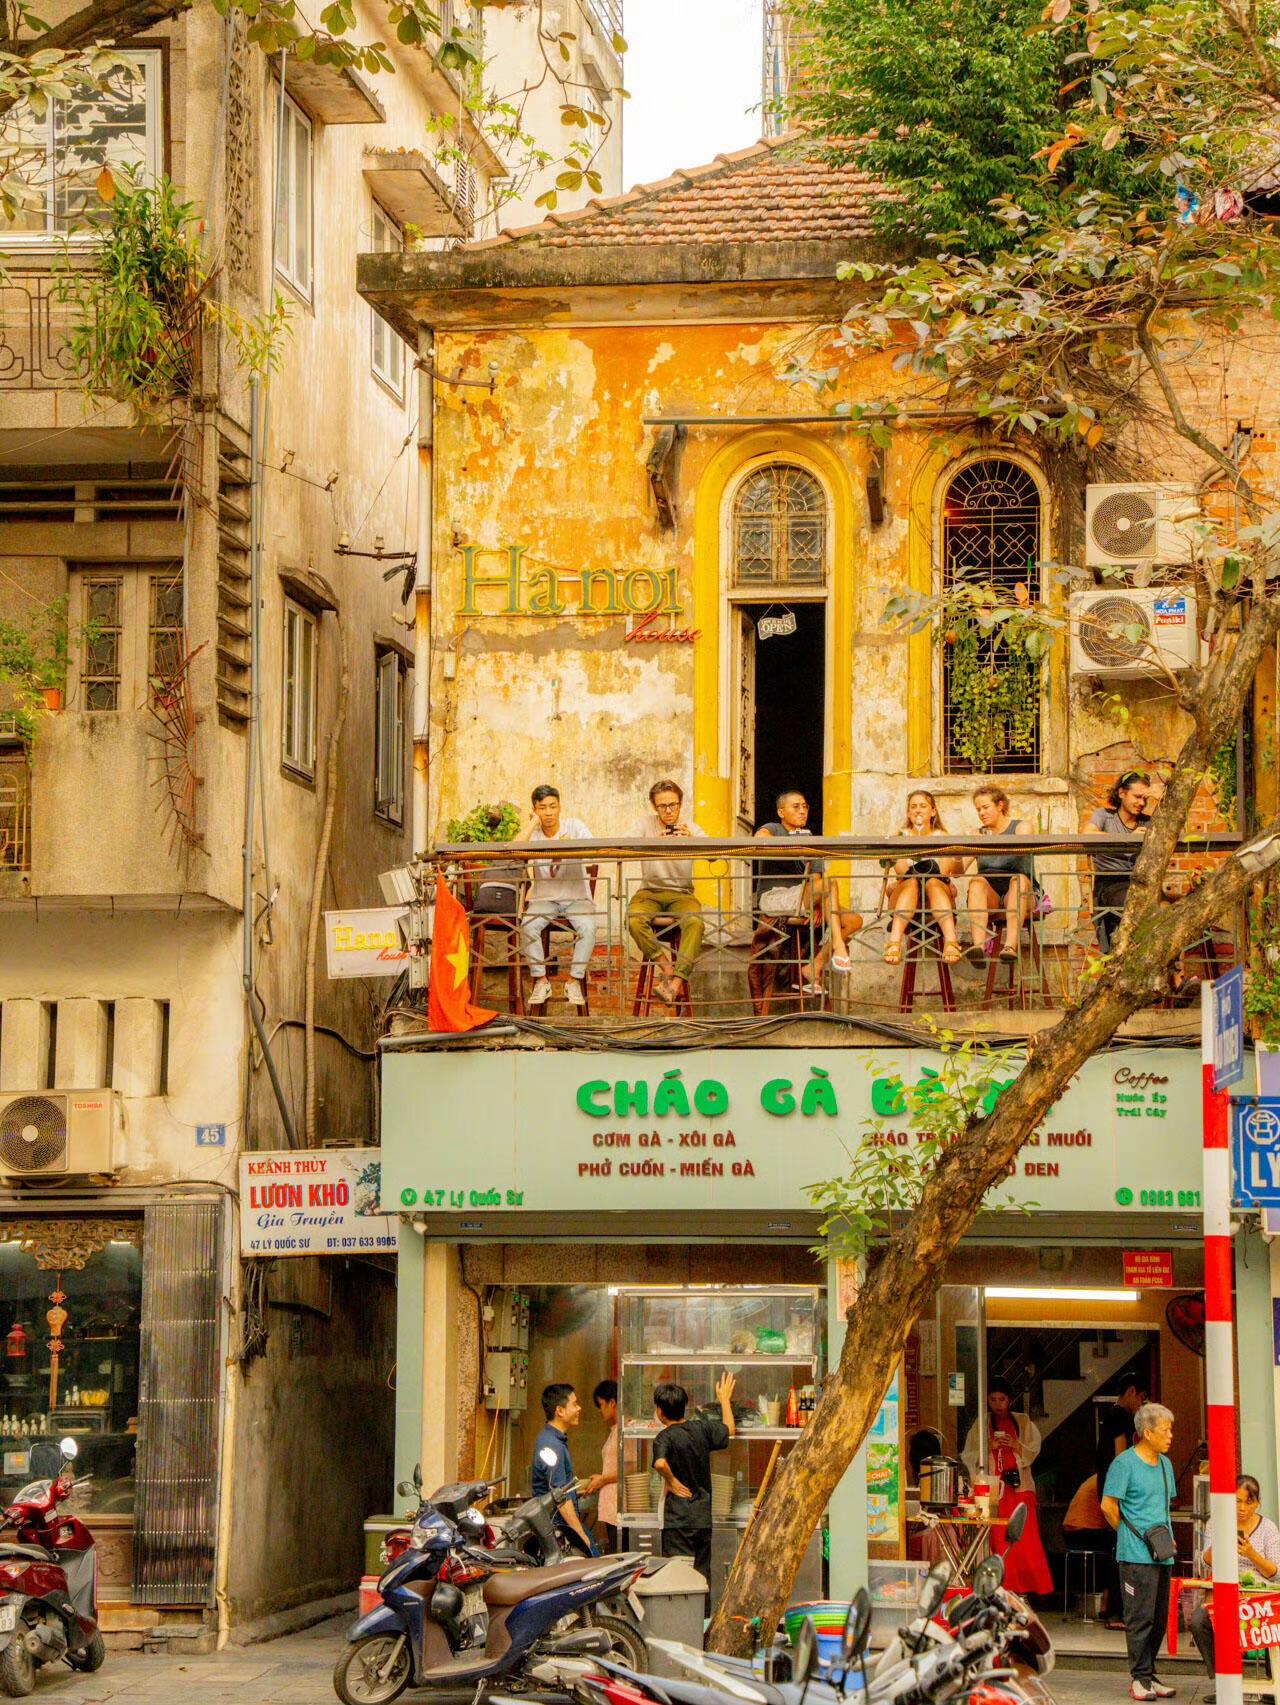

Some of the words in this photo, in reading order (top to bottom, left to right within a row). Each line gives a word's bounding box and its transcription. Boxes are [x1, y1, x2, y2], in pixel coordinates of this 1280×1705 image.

[456, 543, 684, 616] Hanoi
[624, 610, 704, 643] house
[762, 623, 793, 633] OPEN
[332, 926, 400, 951] Hano
[1114, 1067, 1169, 1089] Coffee
[576, 1068, 729, 1116] CHÁO
[760, 1066, 838, 1116] GÀ
[201, 1128, 220, 1143] 45
[592, 1132, 631, 1147] CƠM
[638, 1131, 662, 1147] GÀ
[679, 1131, 706, 1147] XÔI
[713, 1131, 736, 1147] GÀ
[1048, 1129, 1092, 1147] MUỐI
[248, 1159, 291, 1174] KHÁNH
[578, 1158, 611, 1177] PHỞ
[619, 1157, 664, 1176] CUỐN
[680, 1157, 723, 1176] MIẾN
[732, 1159, 755, 1176] GÀ
[1024, 1162, 1059, 1176] ĐEN
[250, 1183, 302, 1209] LƯƠN
[423, 1189, 445, 1206] 47
[450, 1190, 464, 1208] Lý
[469, 1188, 501, 1207] Quốc
[257, 1212, 284, 1229] Gia
[290, 1210, 345, 1227] Truyền
[251, 1240, 260, 1250] 47
[263, 1236, 272, 1249] LÝ
[275, 1235, 296, 1249] QUỐC
[300, 1238, 311, 1248] SƯ
[327, 1237, 340, 1248] ĐT:
[342, 1237, 357, 1248] 037
[359, 1236, 374, 1247] 633
[1239, 1597, 1274, 1620] ỐM
